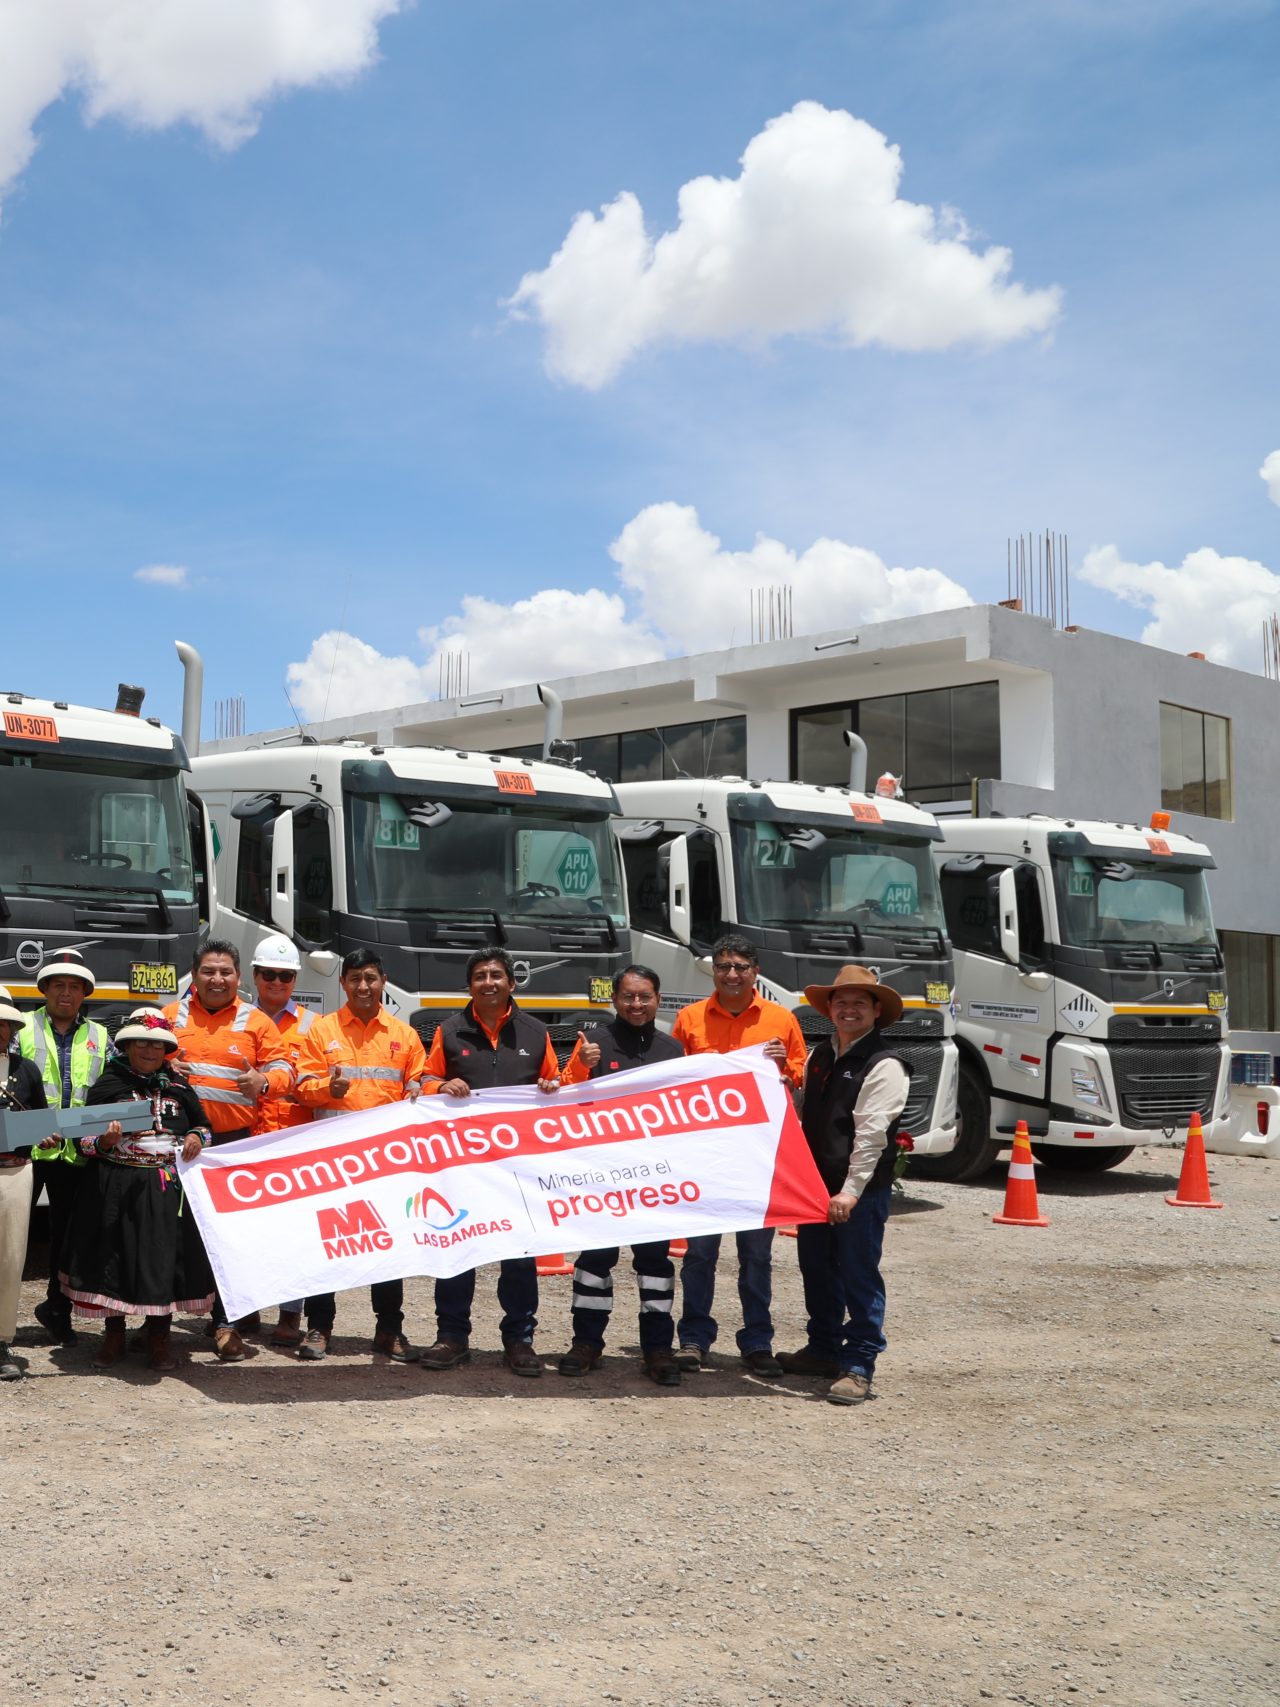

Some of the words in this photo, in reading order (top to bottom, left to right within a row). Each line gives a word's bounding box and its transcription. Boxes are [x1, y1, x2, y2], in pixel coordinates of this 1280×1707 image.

[6, 715, 53, 737] UN-3077
[498, 774, 532, 791] UN-3077
[564, 854, 589, 871] APU
[564, 871, 588, 889] 010
[887, 887, 911, 901] APU
[132, 971, 175, 989] BZW-861
[591, 984, 611, 998] BZW-8
[583, 1021, 598, 1030] FM
[1078, 1020, 1084, 1028] 9
[226, 1122, 520, 1203] Compromiso
[533, 1084, 747, 1143] cumplido
[538, 1169, 605, 1192] Minería
[610, 1165, 651, 1184] para
[655, 1159, 672, 1176] el
[547, 1180, 701, 1227] progreso
[323, 1229, 394, 1260] MMG
